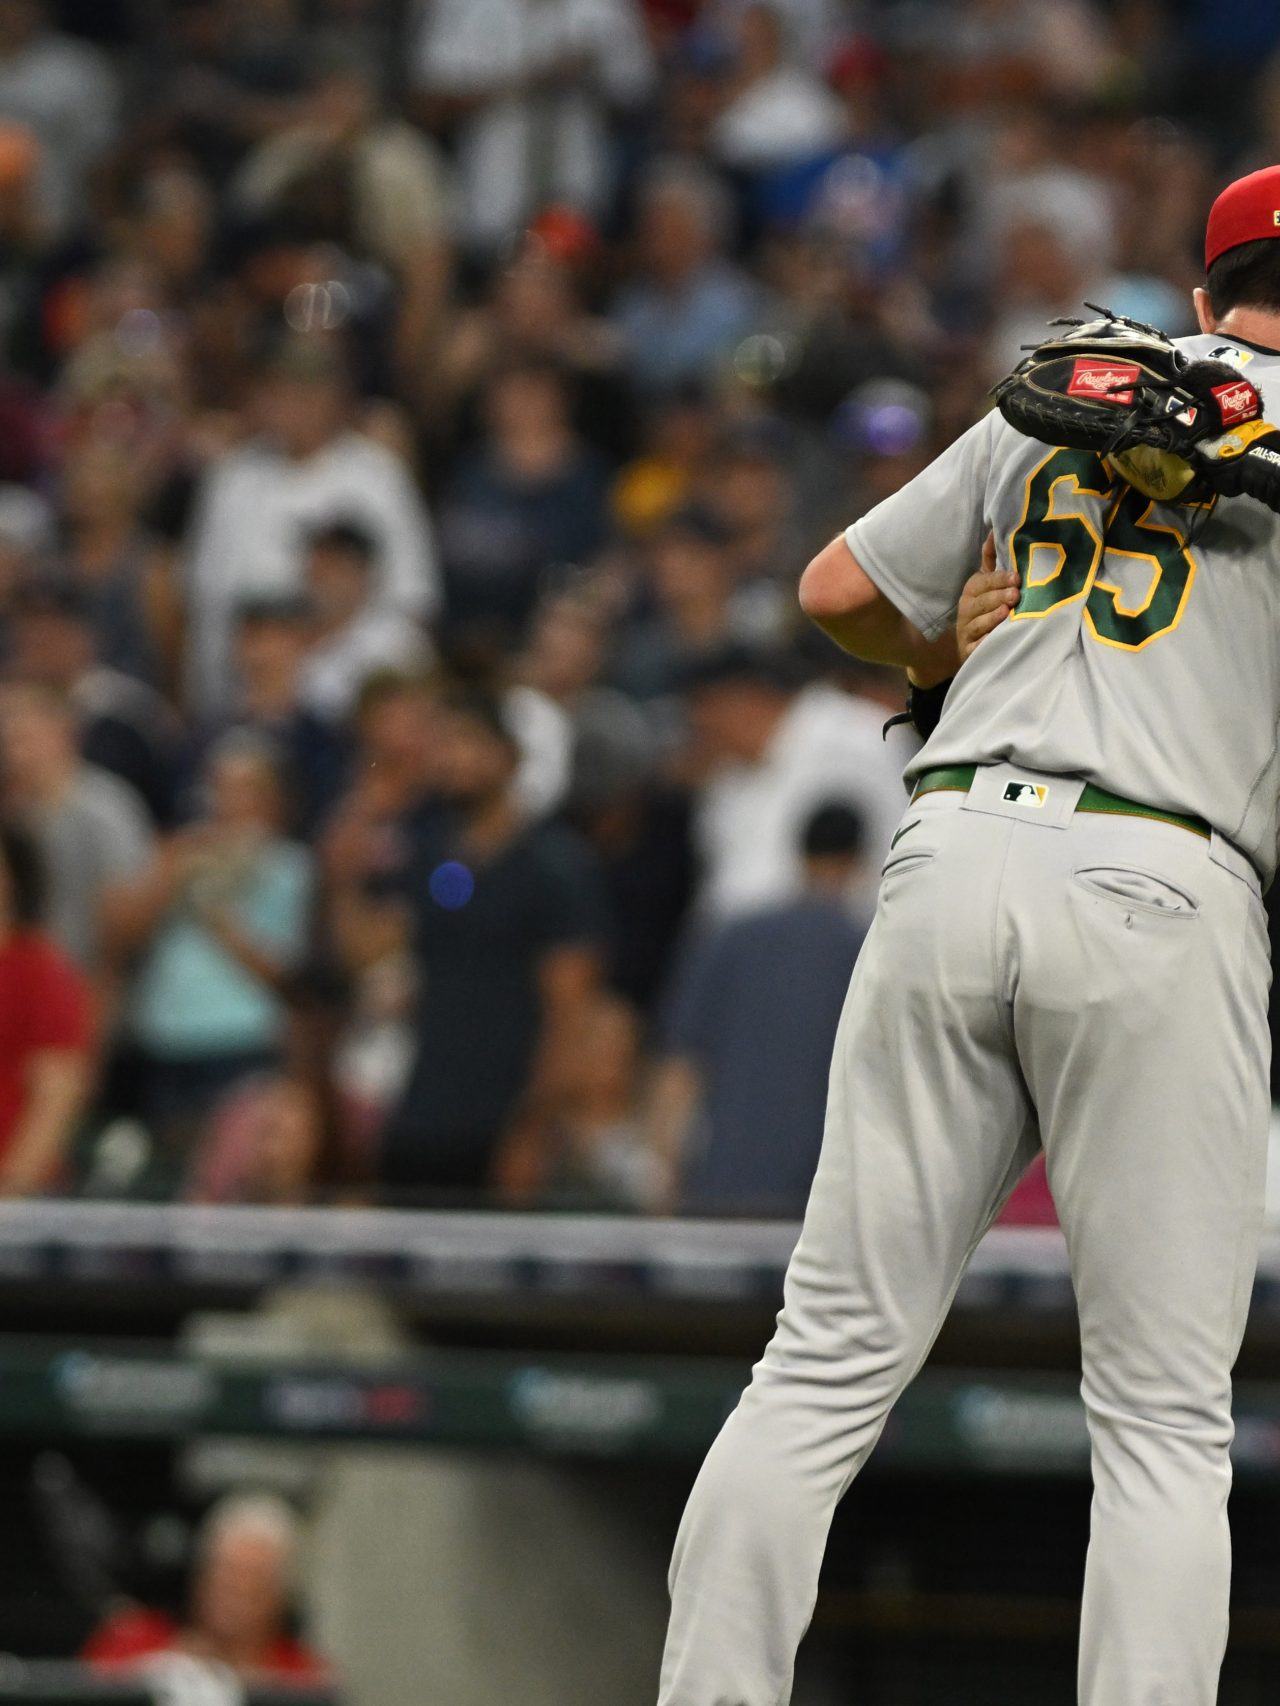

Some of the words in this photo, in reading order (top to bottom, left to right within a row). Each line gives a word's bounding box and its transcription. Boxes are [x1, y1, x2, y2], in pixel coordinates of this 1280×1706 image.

[1076, 371, 1130, 391] Rawlings
[1222, 389, 1252, 410] Rawlings
[1009, 446, 1218, 653] 65
